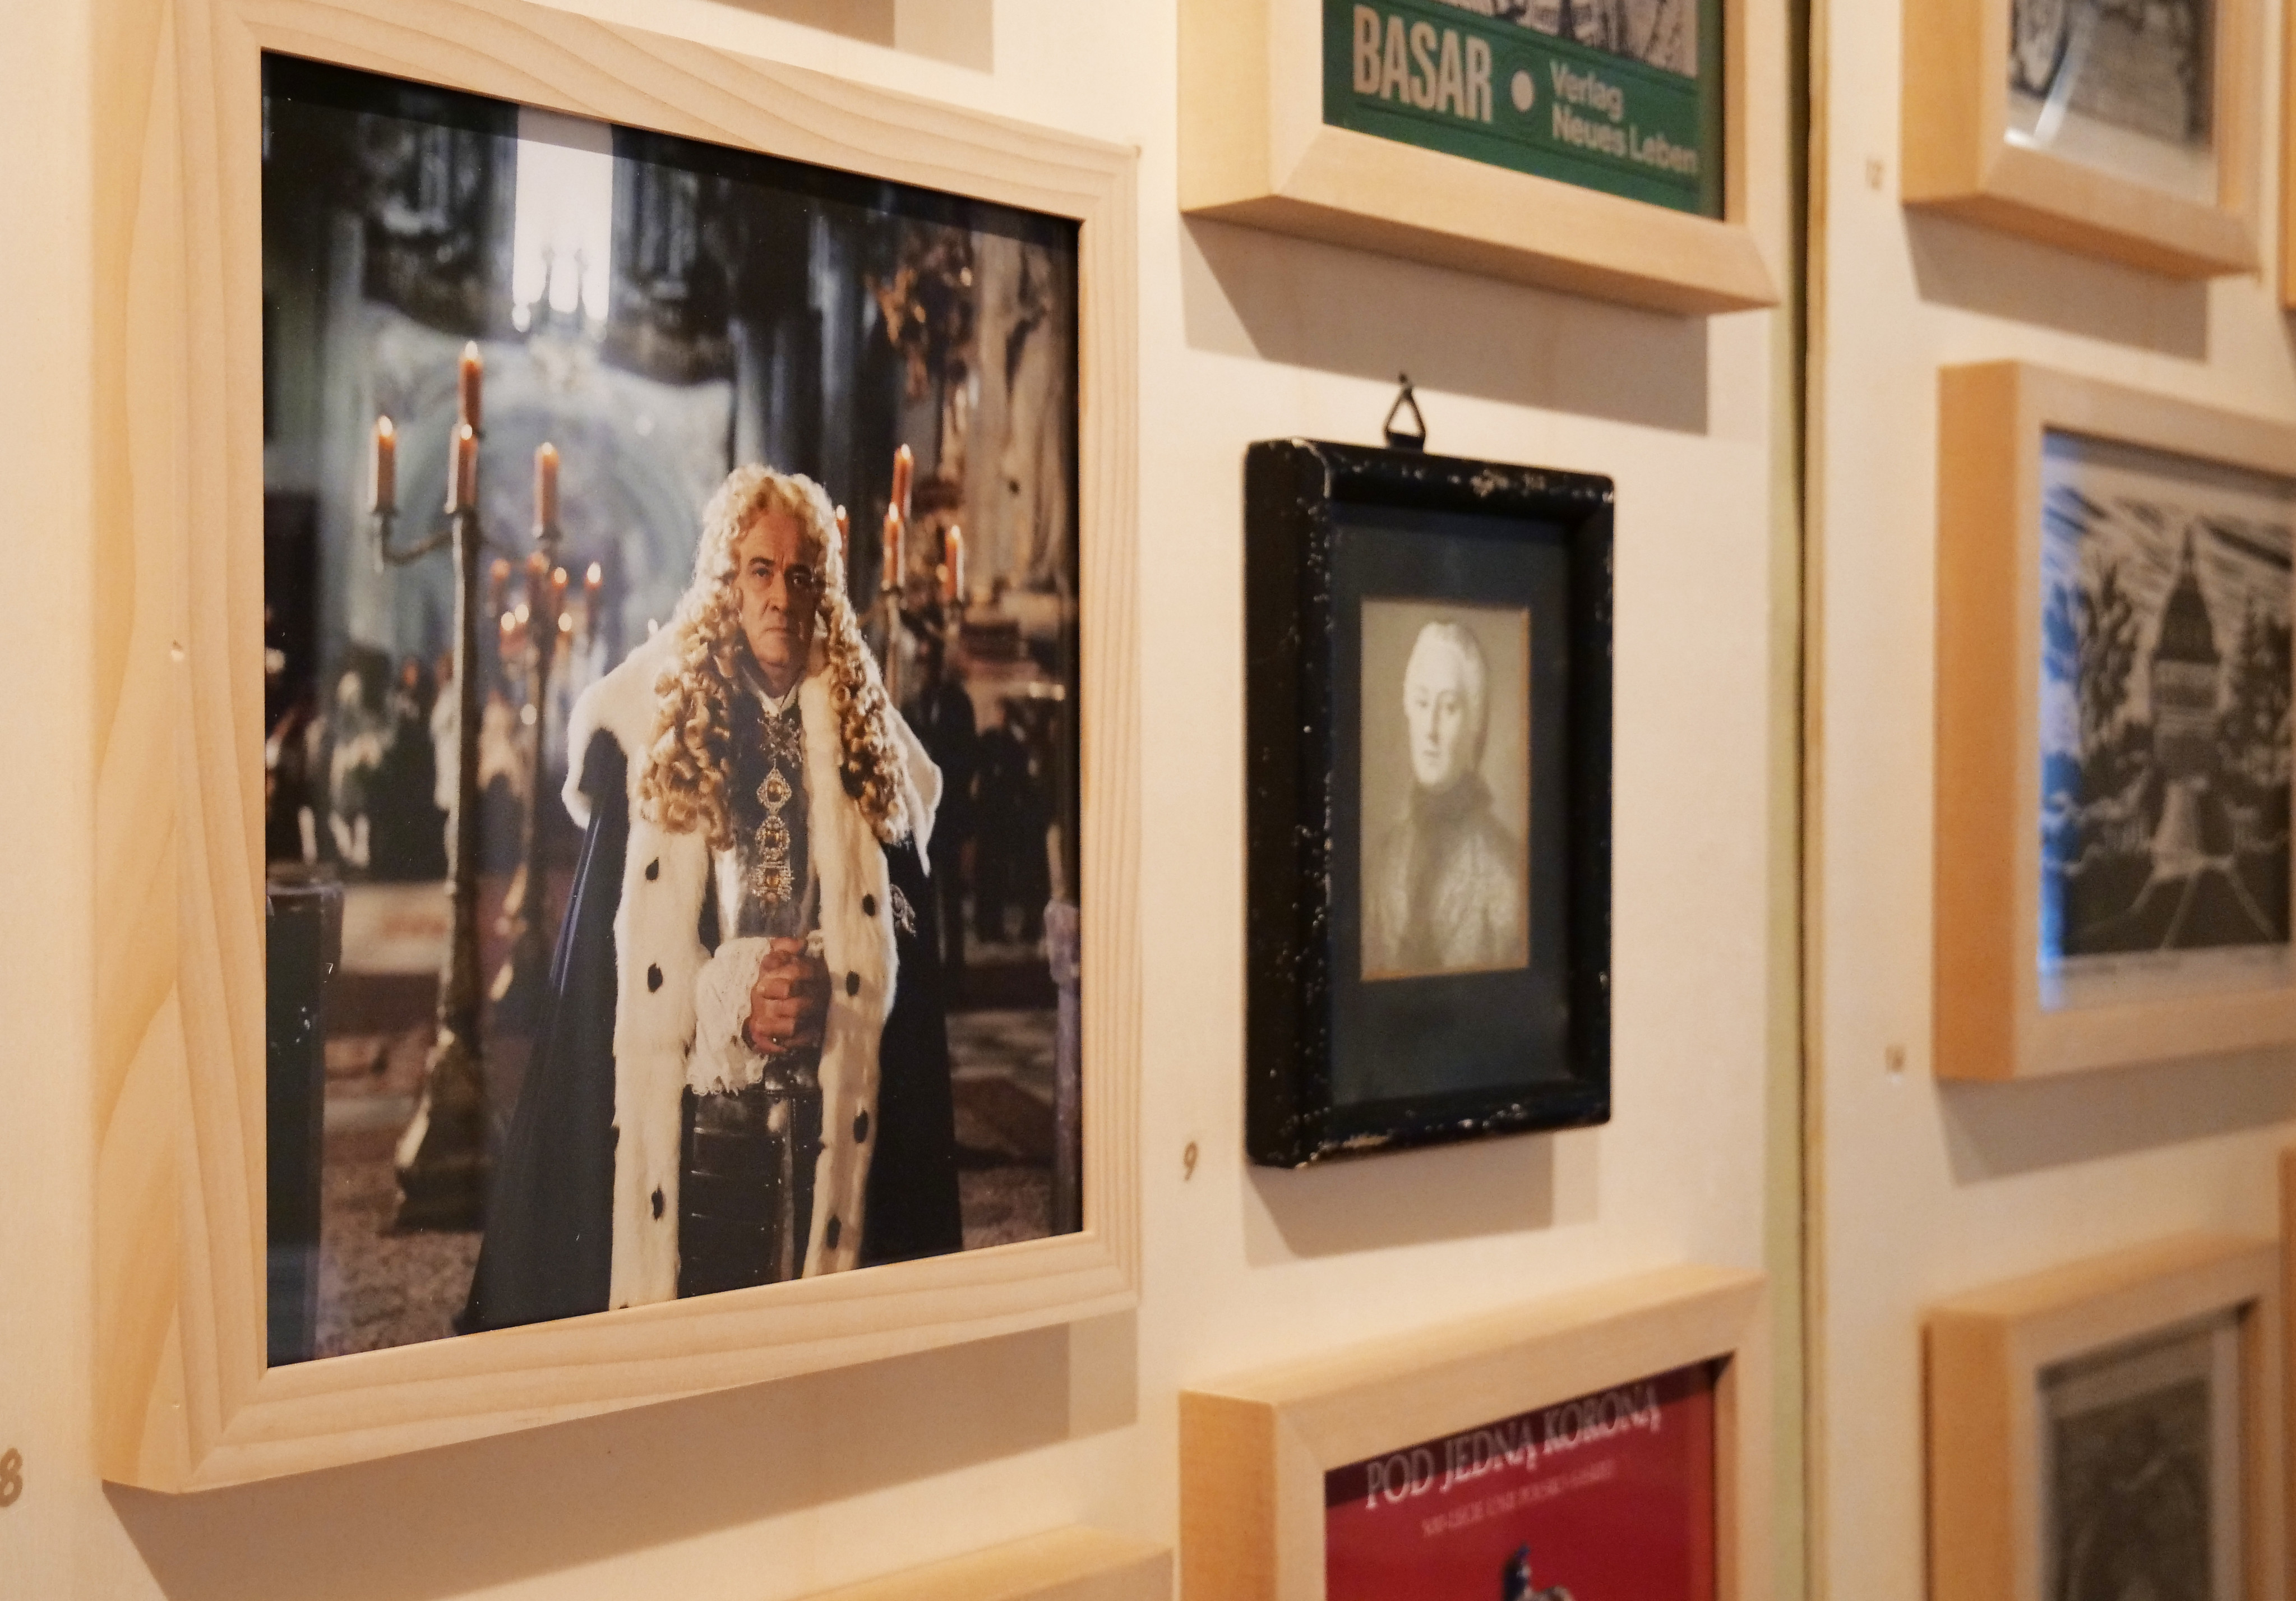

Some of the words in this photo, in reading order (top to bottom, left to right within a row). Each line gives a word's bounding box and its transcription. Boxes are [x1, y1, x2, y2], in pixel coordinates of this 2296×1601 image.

[1353, 4, 1493, 124] BASAR
[1550, 59, 1623, 122] Verlag
[1552, 103, 1625, 158] Neues
[1629, 124, 1698, 174] Leben
[1184, 1141, 1198, 1180] 9
[1366, 1448, 1434, 1511] POD
[1439, 1419, 1536, 1493] JEDNĄ
[1542, 1383, 1662, 1455] KORONĄ
